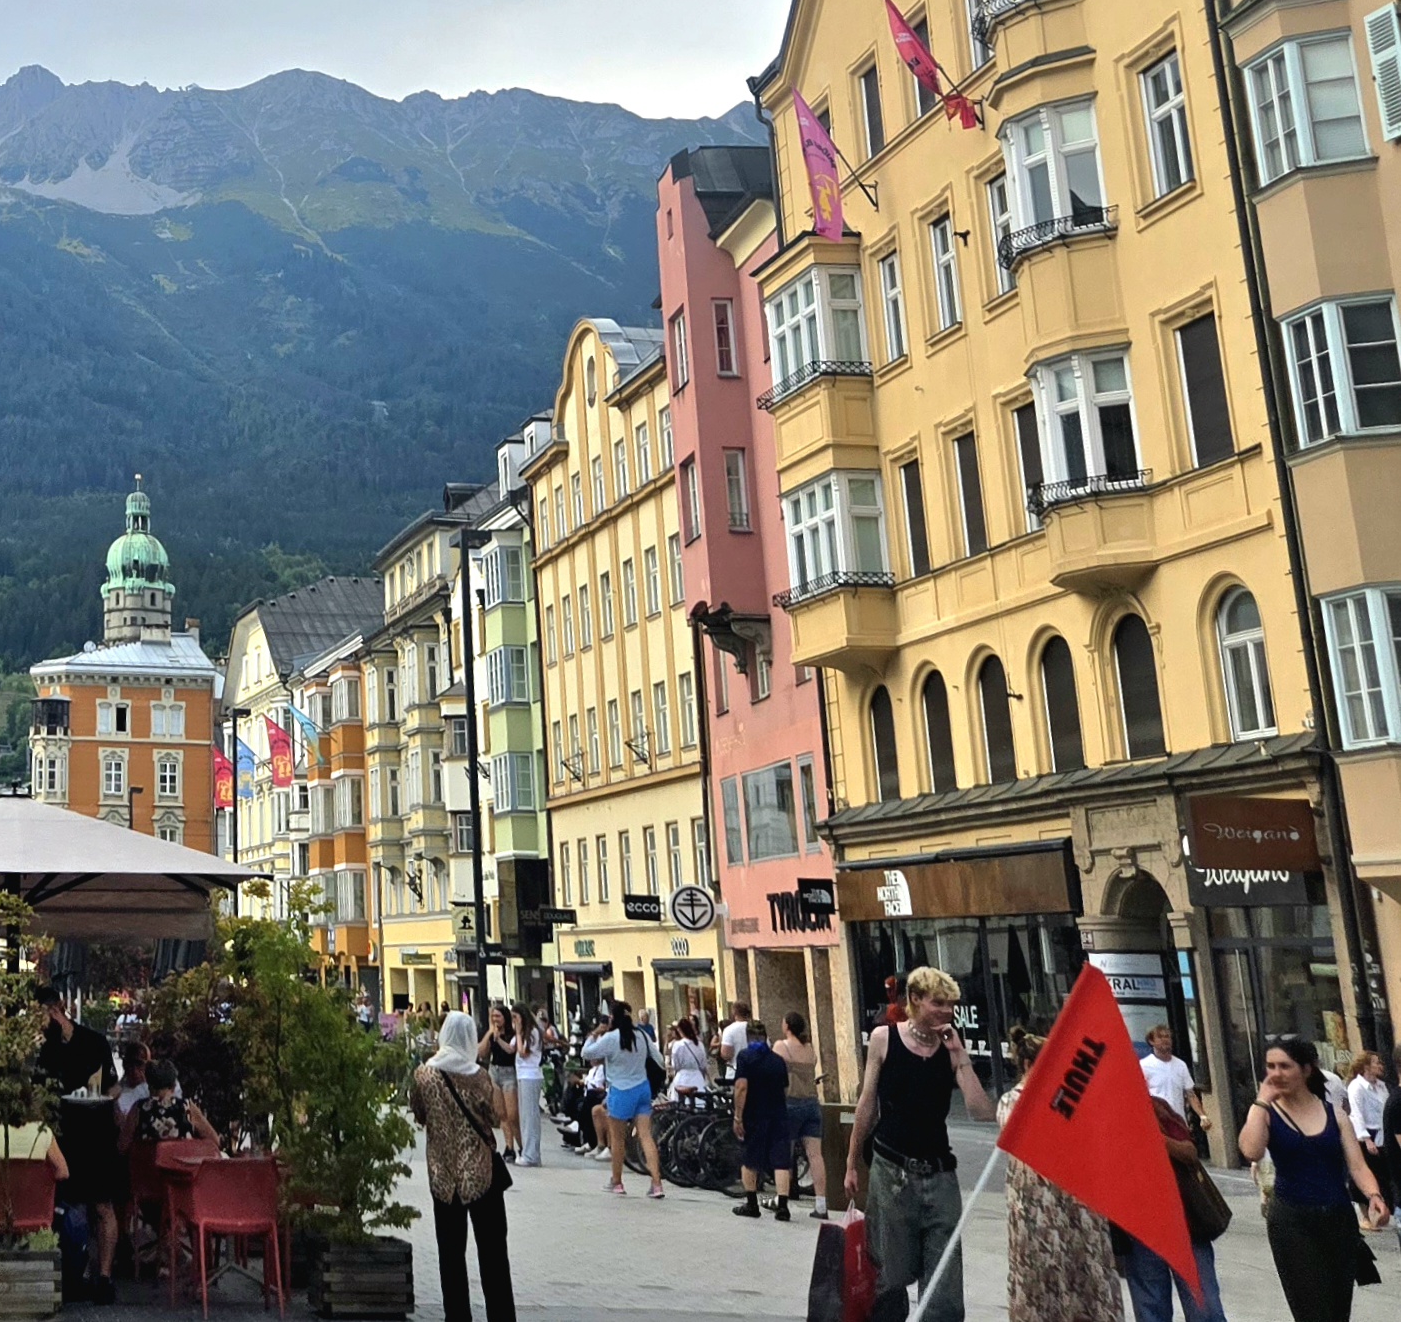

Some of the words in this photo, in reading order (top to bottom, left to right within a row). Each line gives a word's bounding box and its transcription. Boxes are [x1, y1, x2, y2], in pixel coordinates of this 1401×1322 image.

[1202, 822, 1300, 844] Weigand
[883, 870, 899, 886] THE
[877, 886, 902, 901] NORTH
[626, 902, 659, 914] ecco
[884, 901, 902, 916] FACE
[953, 1005, 979, 1029] SALE
[1050, 1036, 1106, 1120] THULE
